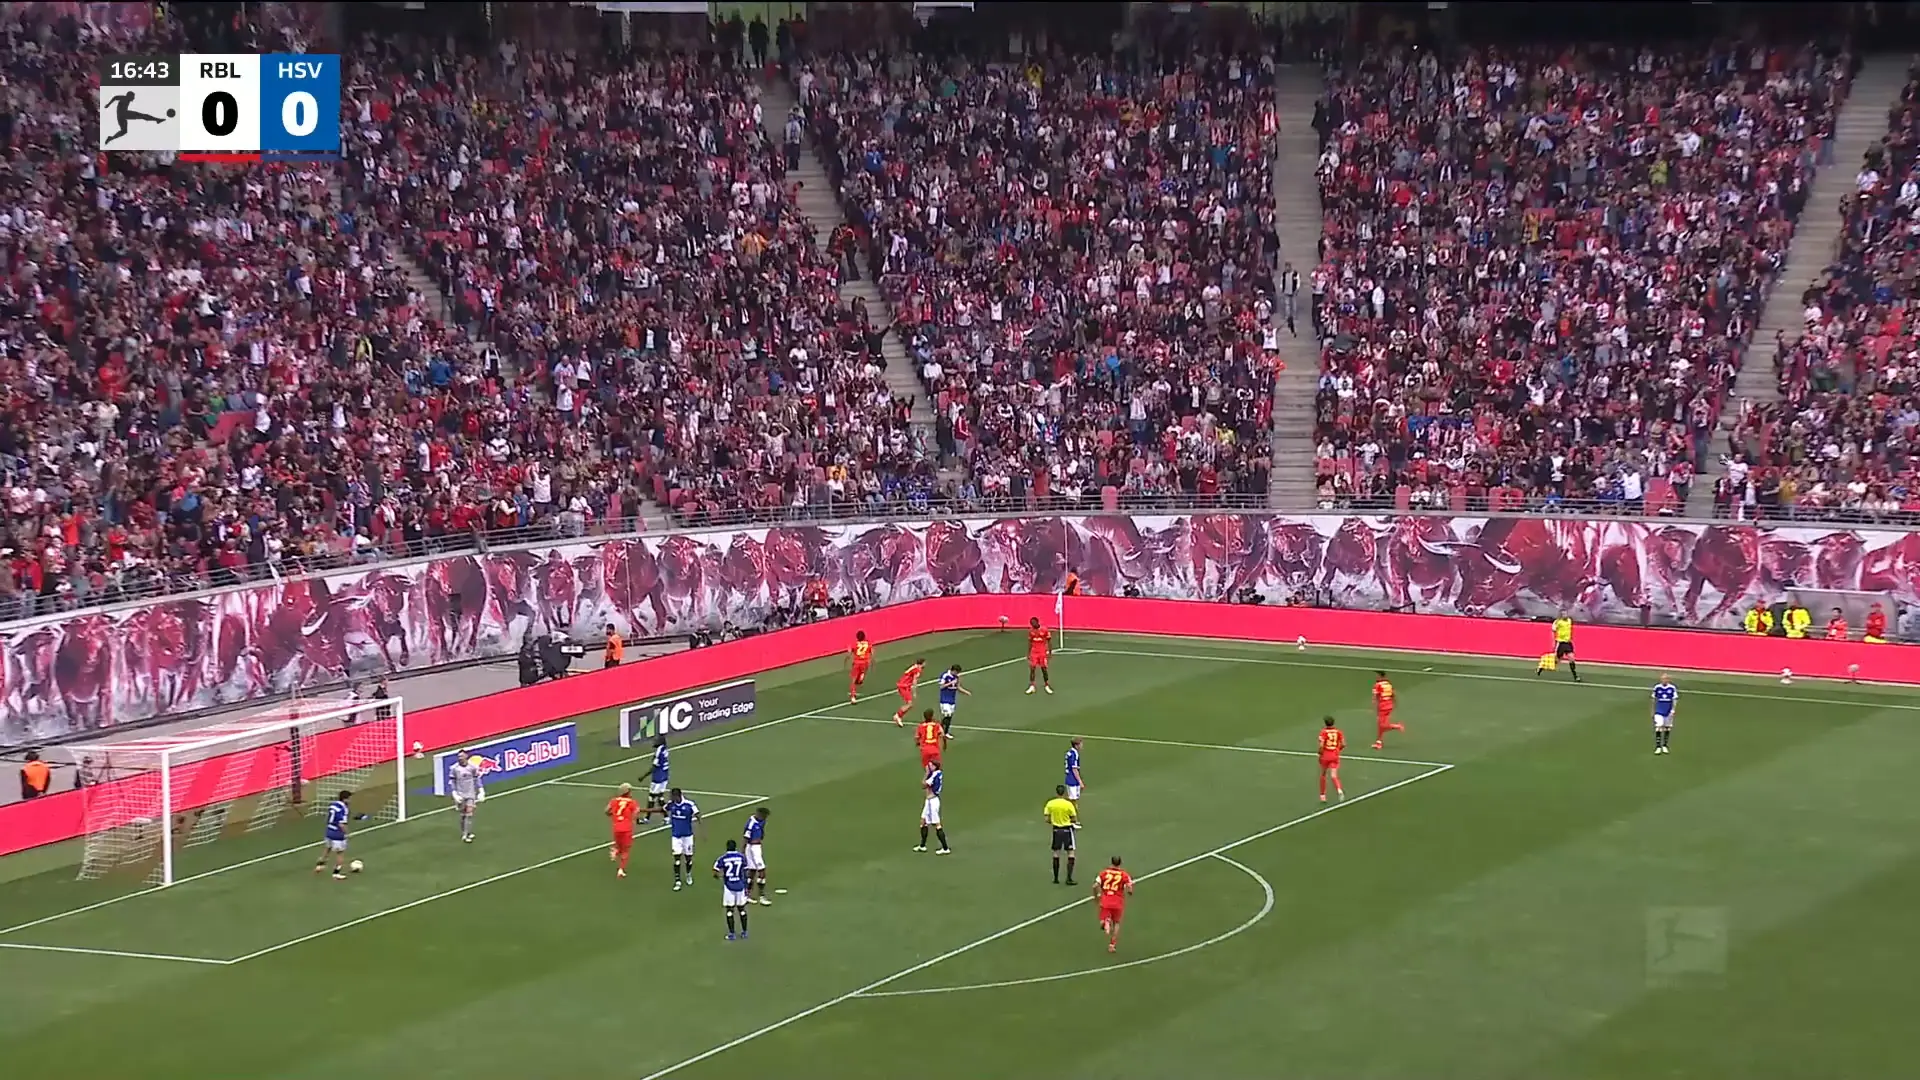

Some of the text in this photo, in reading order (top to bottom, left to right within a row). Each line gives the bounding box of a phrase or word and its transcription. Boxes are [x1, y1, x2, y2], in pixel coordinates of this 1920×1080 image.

[698, 697, 719, 709] Your
[698, 701, 754, 722] Trading Edge
[618, 801, 628, 816] 7
[724, 861, 742, 877] 27
[1103, 873, 1122, 891] 22
